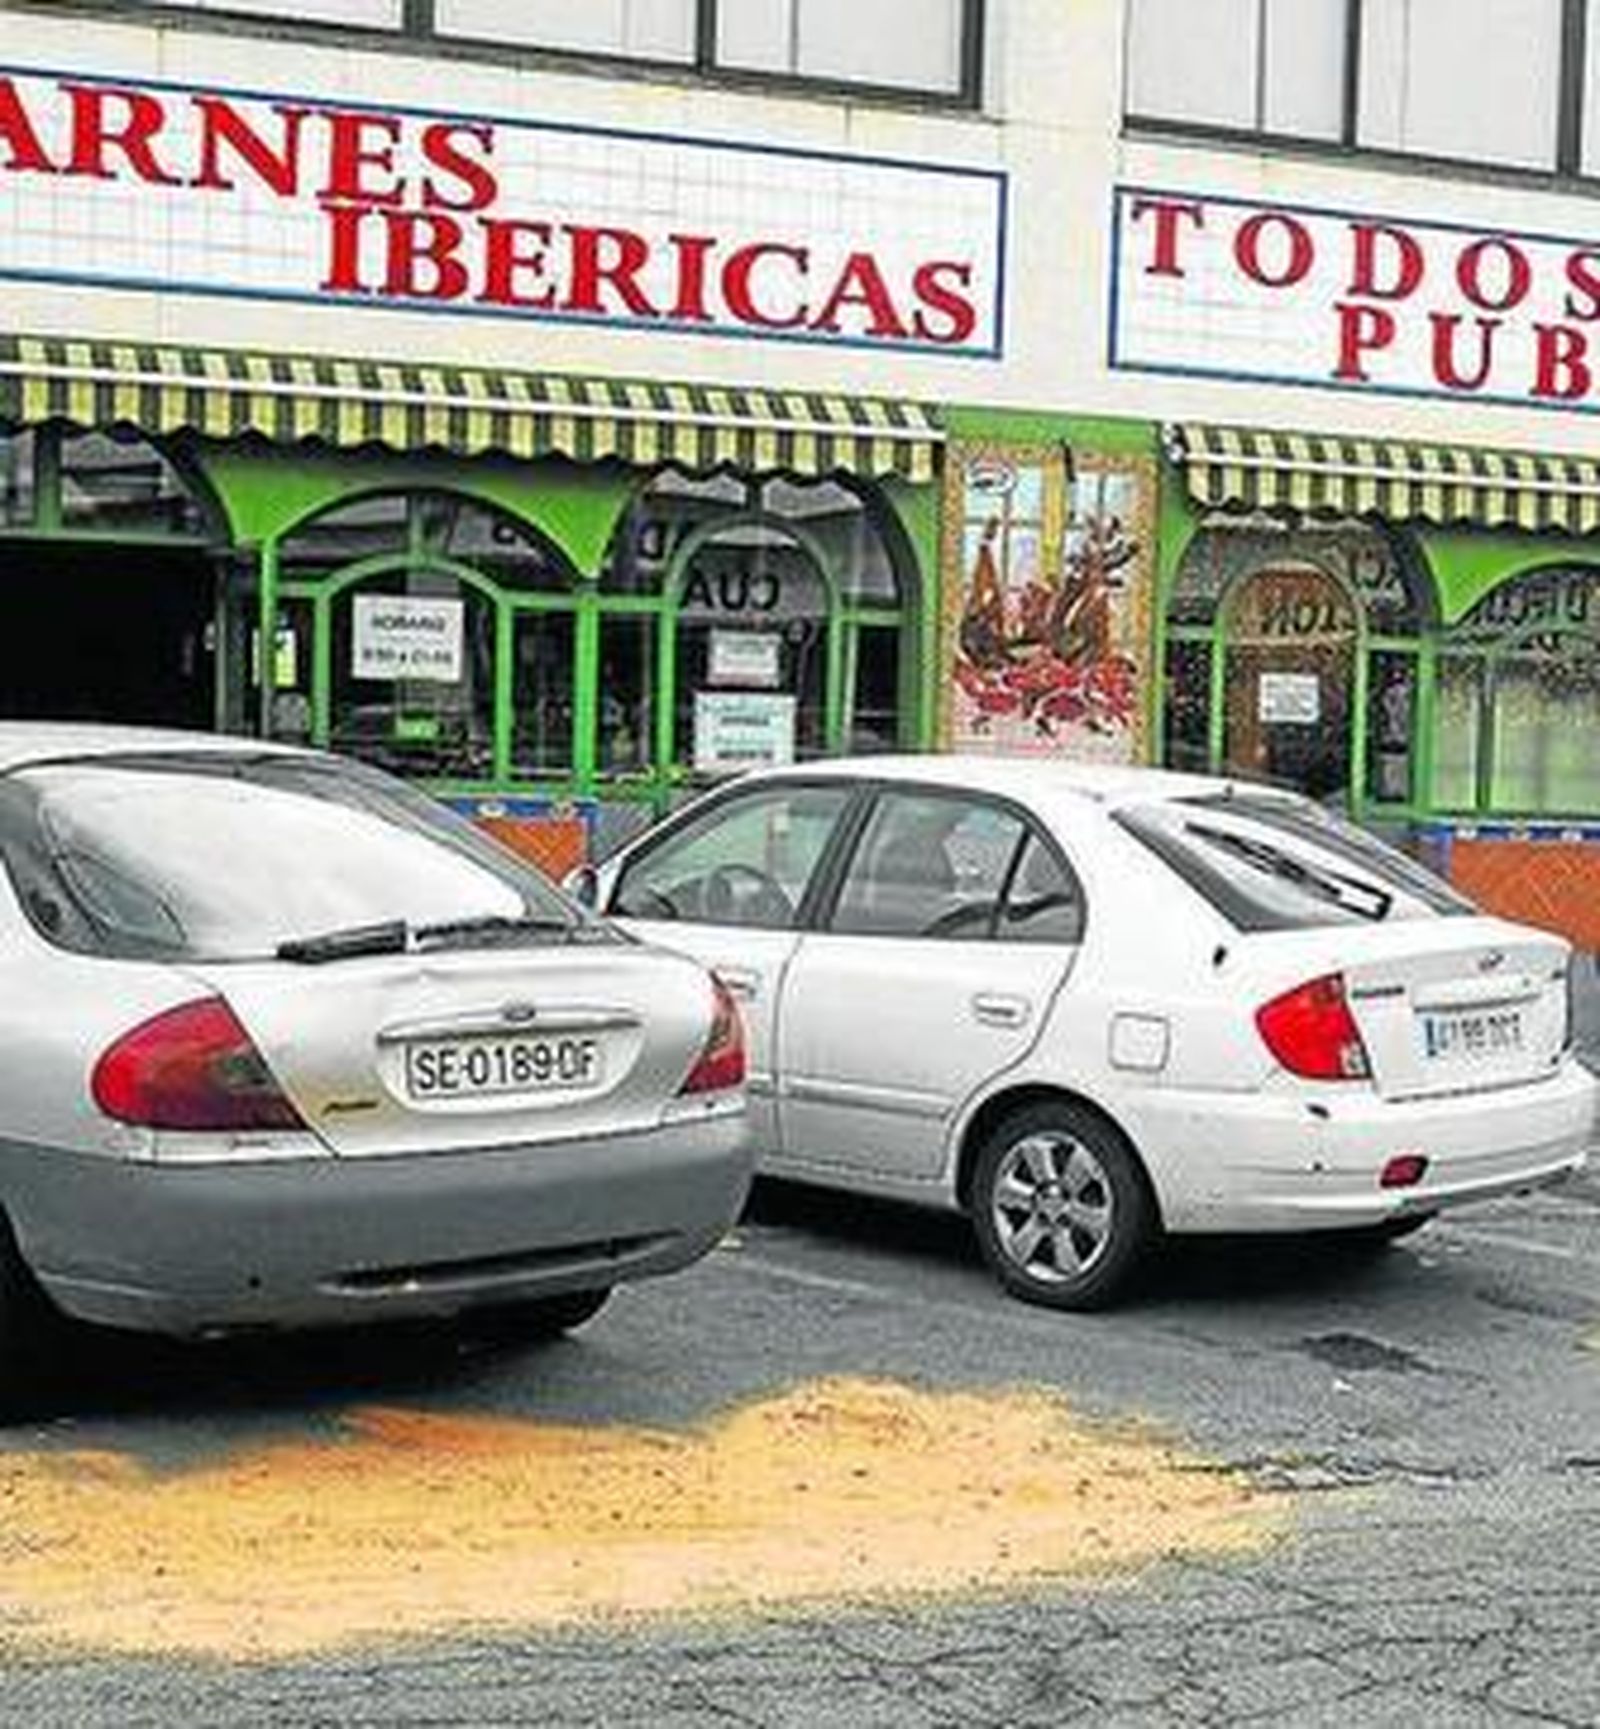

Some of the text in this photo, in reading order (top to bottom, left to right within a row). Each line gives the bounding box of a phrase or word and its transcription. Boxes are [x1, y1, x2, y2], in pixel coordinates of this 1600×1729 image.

[318, 203, 977, 343] IBERICAS
[1130, 198, 1600, 322] TODOS
[1330, 302, 1592, 399] PUB
